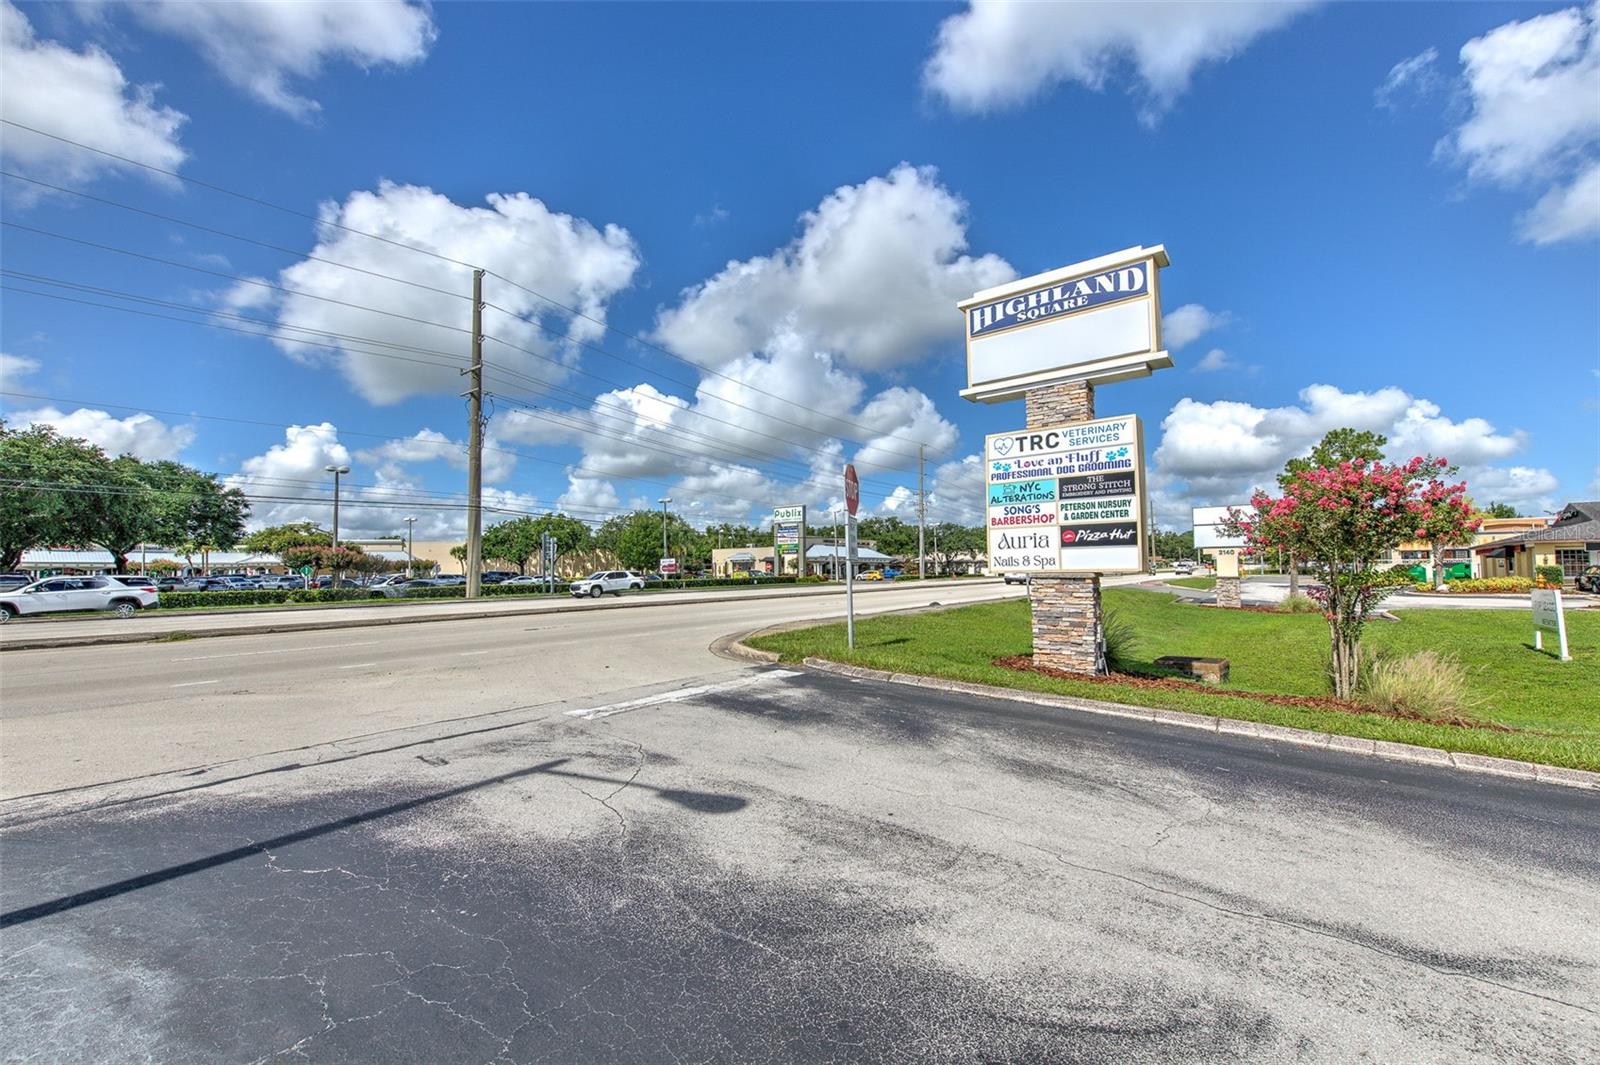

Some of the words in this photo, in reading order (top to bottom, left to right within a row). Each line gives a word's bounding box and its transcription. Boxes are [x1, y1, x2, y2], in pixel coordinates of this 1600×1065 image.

[971, 267, 1145, 333] HIGHLAND
[1016, 296, 1088, 322] SQUARE
[1062, 422, 1127, 438] VETERINARY
[1015, 432, 1060, 452] TRC
[1069, 433, 1120, 446] SERVICES
[1014, 459, 1045, 469] Love
[1047, 457, 1063, 466] an
[1065, 449, 1103, 464] Fluff
[991, 467, 1054, 481] PROFESSIONAL
[1056, 465, 1075, 475] DOG
[1078, 459, 1132, 473] GROOMING
[846, 479, 858, 501] STOP
[1019, 481, 1041, 492] NYC
[1062, 483, 1096, 492] STRONG
[1098, 480, 1131, 489] STITCH
[991, 491, 1055, 504] ALTERATIONS
[1004, 504, 1041, 516] SONG'S
[1060, 502, 1096, 511] PETERSON
[1097, 499, 1132, 509] NURSURY
[774, 509, 802, 518] Publix
[991, 513, 1055, 526] BARBERSHOP
[1064, 513, 1068, 521] &
[1071, 511, 1099, 520] GARDEN
[1100, 509, 1130, 519] CENTER
[997, 532, 1050, 550] Auria
[1075, 529, 1108, 542] Pizza
[1108, 528, 1136, 540] Hut
[993, 555, 1020, 567] Nails
[1022, 555, 1031, 567] &
[1033, 555, 1056, 570] Spa
